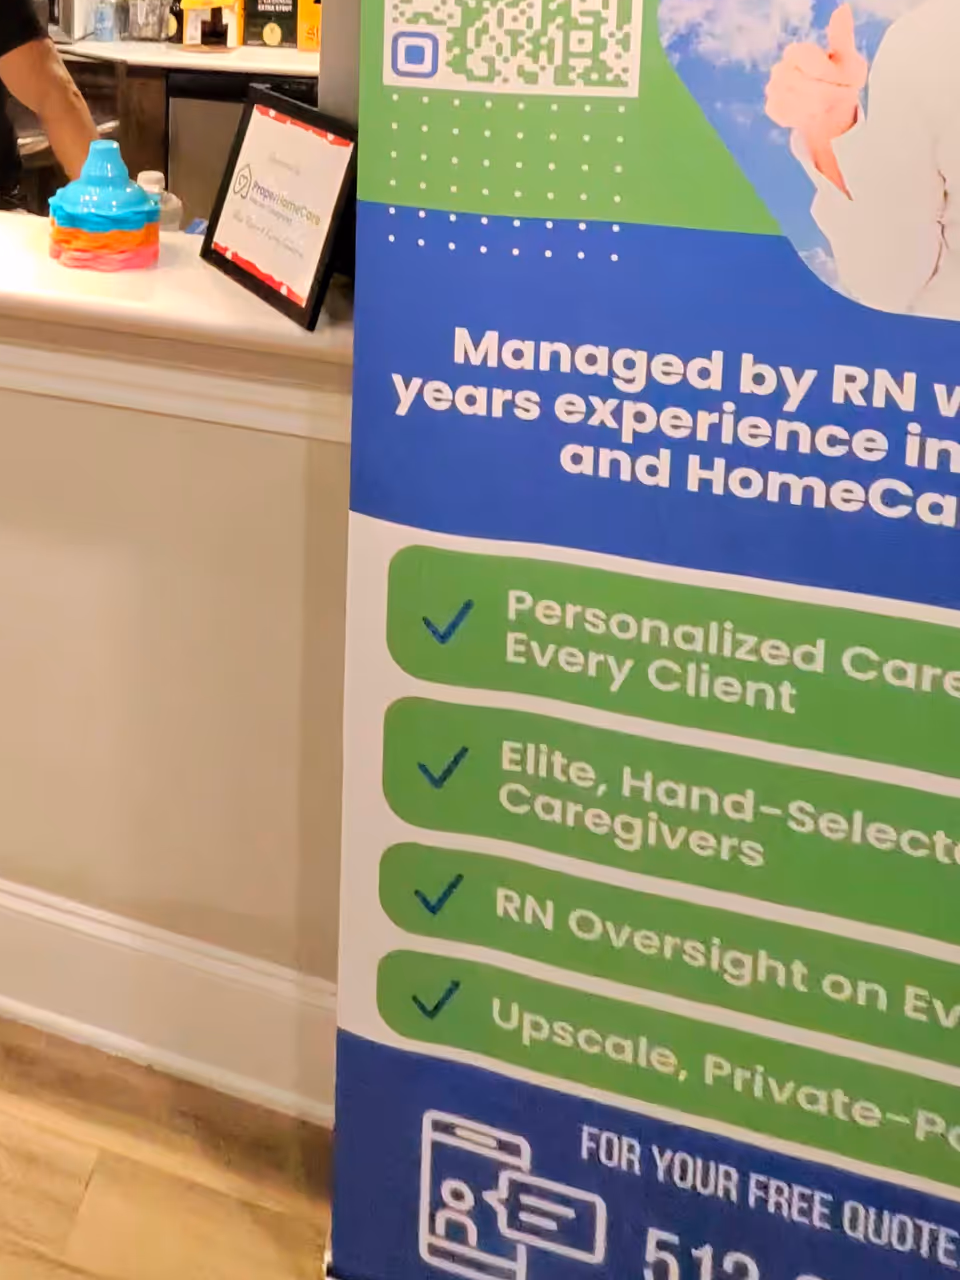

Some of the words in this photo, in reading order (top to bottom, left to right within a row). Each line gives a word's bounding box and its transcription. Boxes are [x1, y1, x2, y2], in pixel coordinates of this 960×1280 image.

[453, 326, 724, 393] Managed
[741, 353, 818, 412] by
[832, 364, 917, 413] RN
[391, 373, 541, 421] years
[554, 392, 889, 462] experience
[905, 422, 960, 474] in
[560, 444, 671, 488] and
[687, 454, 957, 528] HomeCa
[506, 589, 825, 674] Personalized
[841, 646, 960, 699] Care
[506, 631, 634, 693] Every
[647, 658, 797, 714] Client
[499, 783, 766, 868] Caregivers
[501, 740, 607, 797] Elite,
[622, 765, 960, 865] Hand-Select
[496, 886, 554, 931] RN
[568, 907, 809, 993] Oversight
[821, 972, 888, 1013] on
[904, 983, 960, 1028] Ev
[492, 997, 689, 1082] Upscale,
[581, 1124, 641, 1175] FOR
[652, 1144, 739, 1203] YOUR
[748, 1171, 833, 1231] FREE
[843, 1199, 960, 1268] QUOTE
